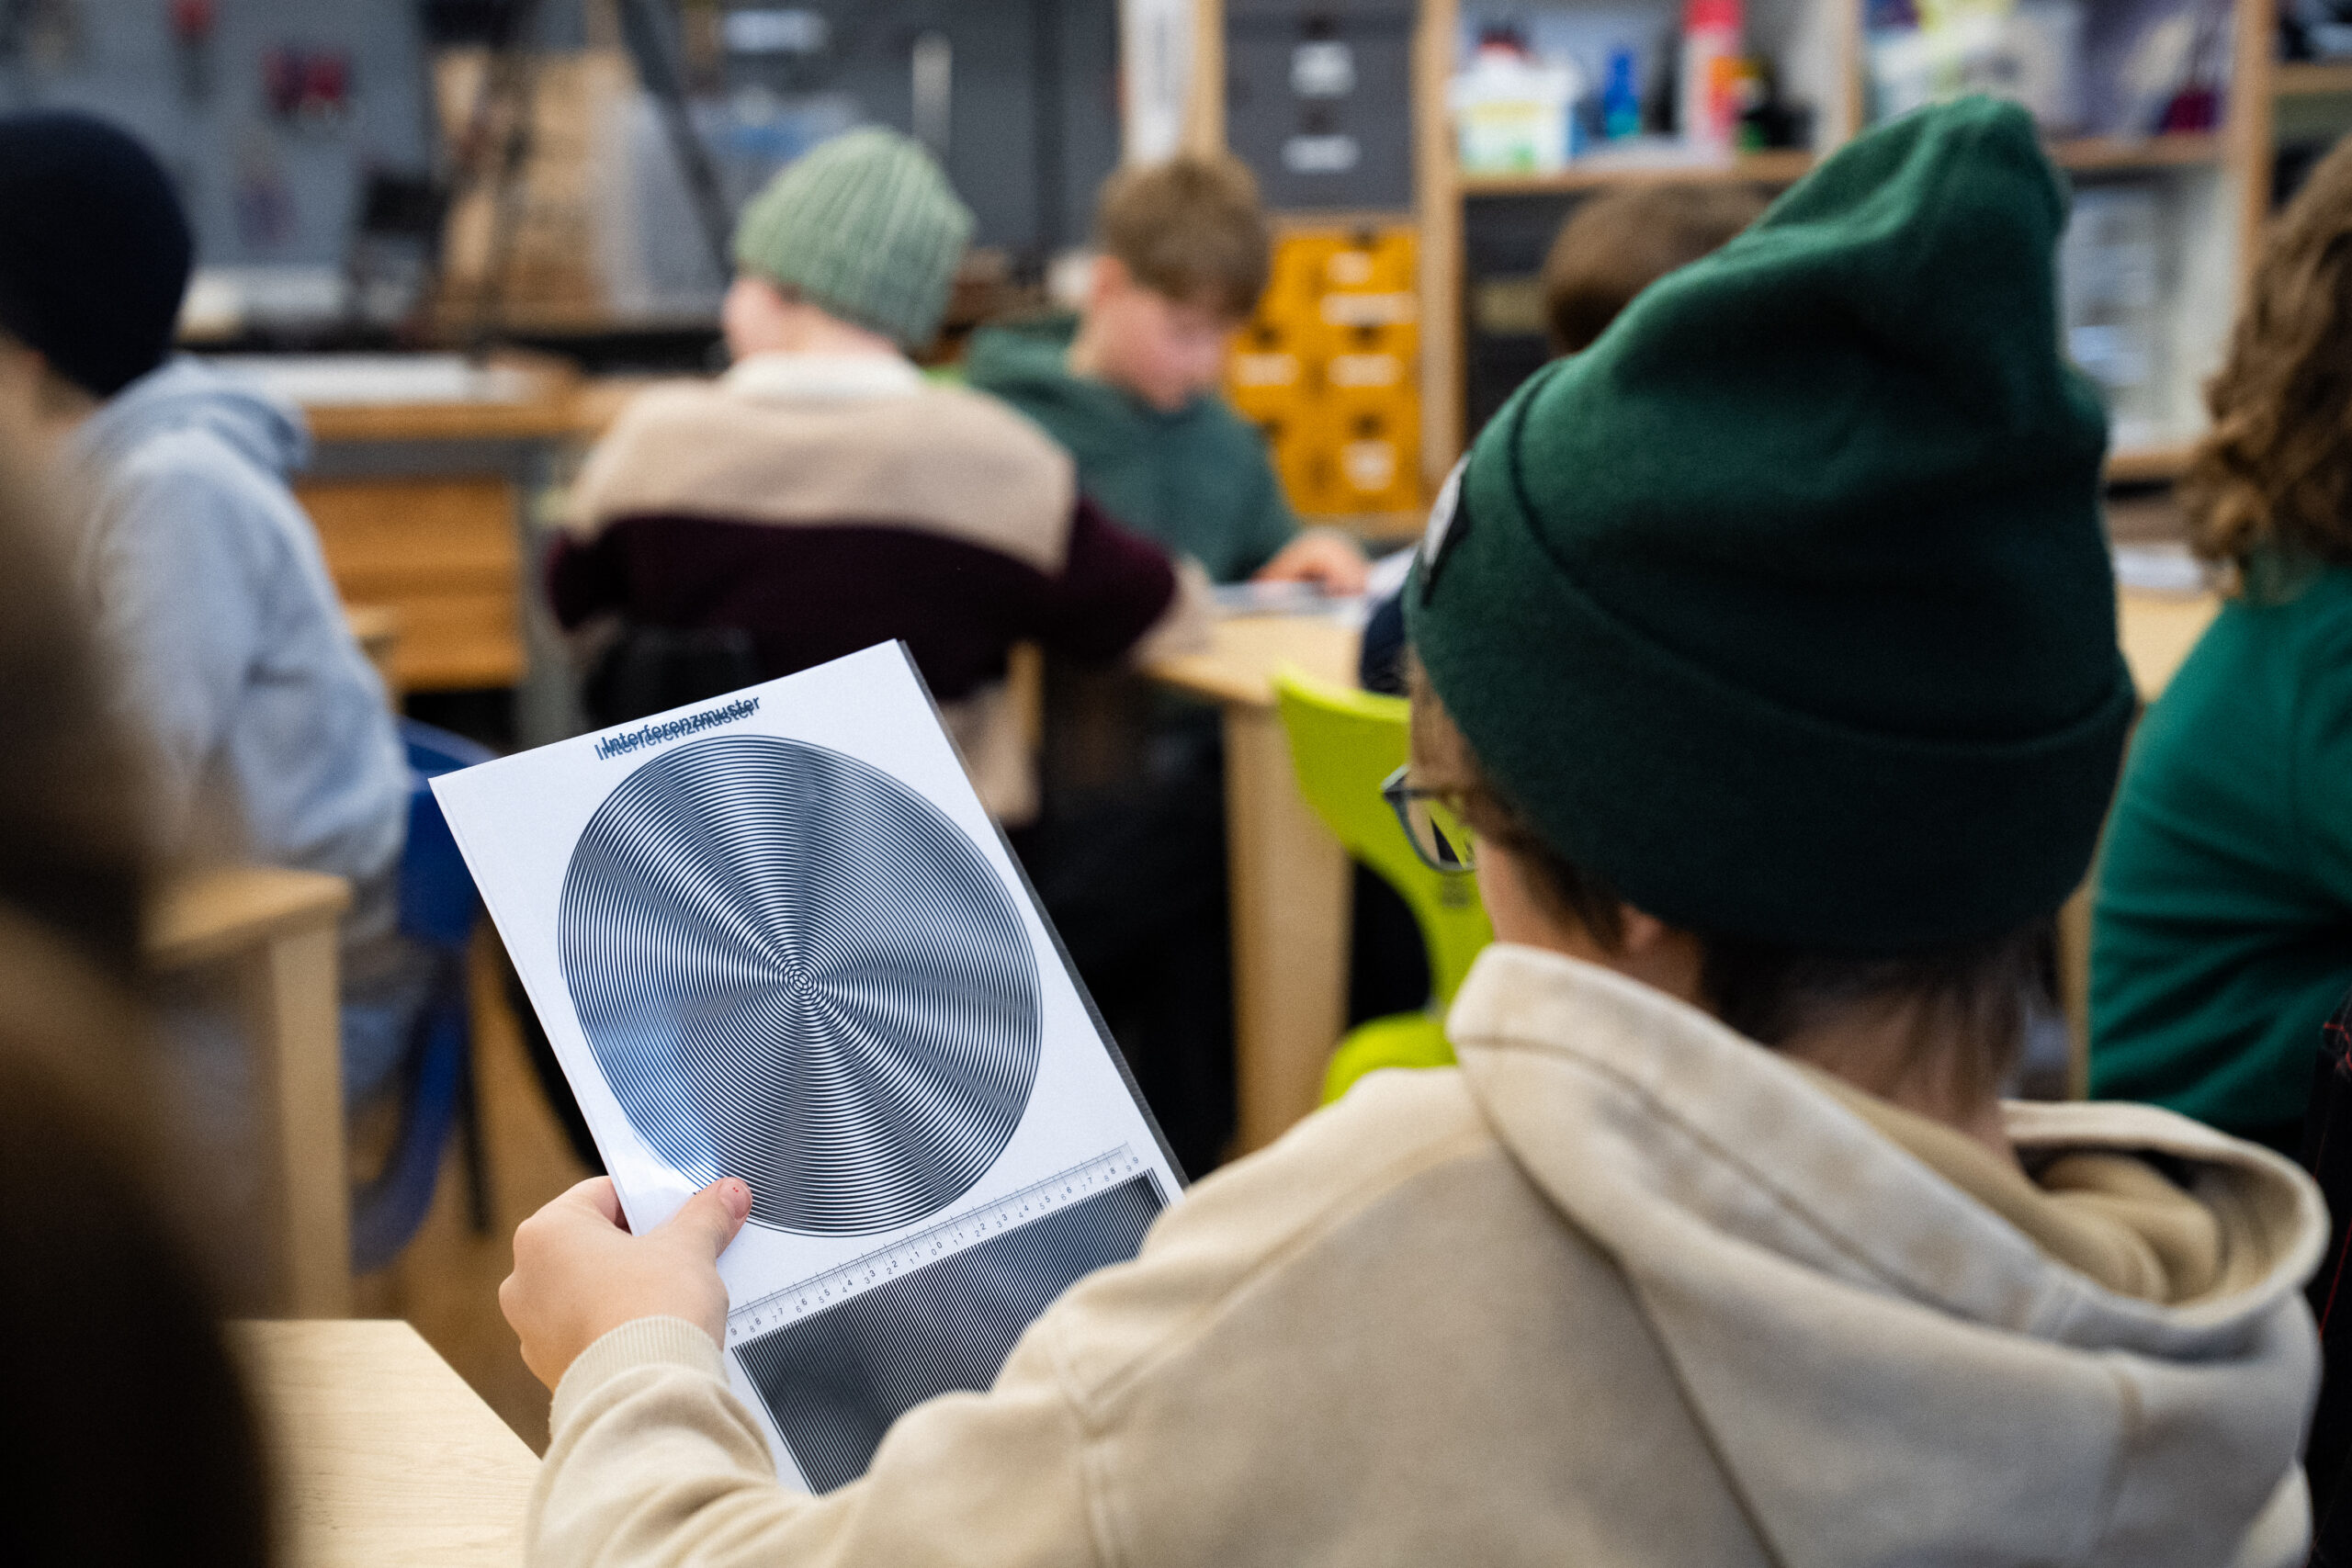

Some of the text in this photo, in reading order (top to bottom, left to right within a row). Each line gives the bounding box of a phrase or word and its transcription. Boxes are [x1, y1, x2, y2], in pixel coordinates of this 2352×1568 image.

[602, 695, 761, 752] Interferenzmuster
[823, 1288, 831, 1296] 5
[869, 1269, 876, 1278] 3
[891, 1259, 898, 1268] 2
[1087, 1176, 1093, 1184] 7
